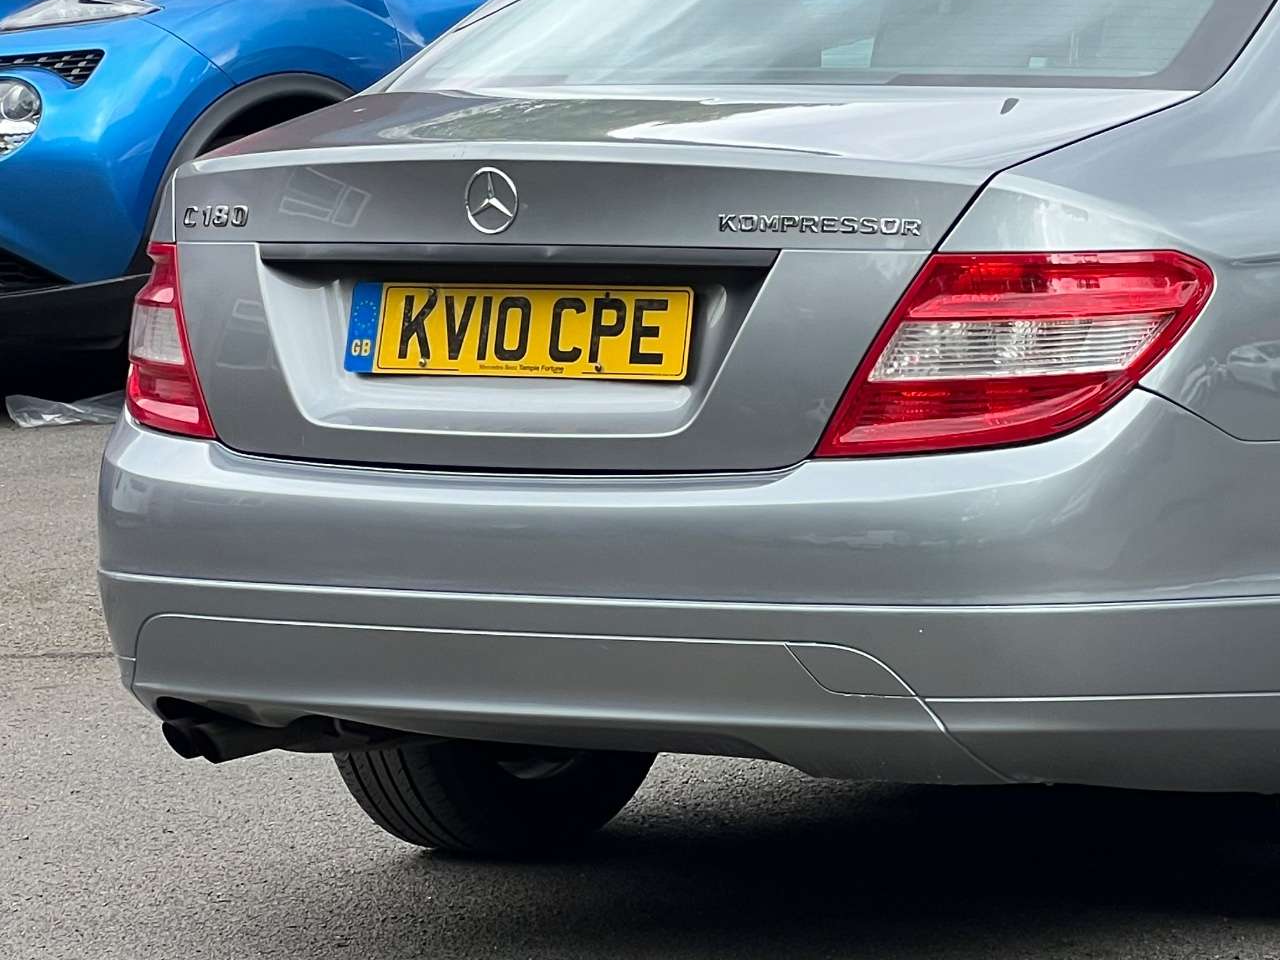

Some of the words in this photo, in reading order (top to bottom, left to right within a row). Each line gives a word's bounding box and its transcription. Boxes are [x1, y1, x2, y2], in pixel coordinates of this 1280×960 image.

[718, 213, 922, 236] KOMPRESSOR
[397, 292, 532, 361] KV10
[548, 295, 669, 365] CPE
[351, 338, 371, 357] GB
